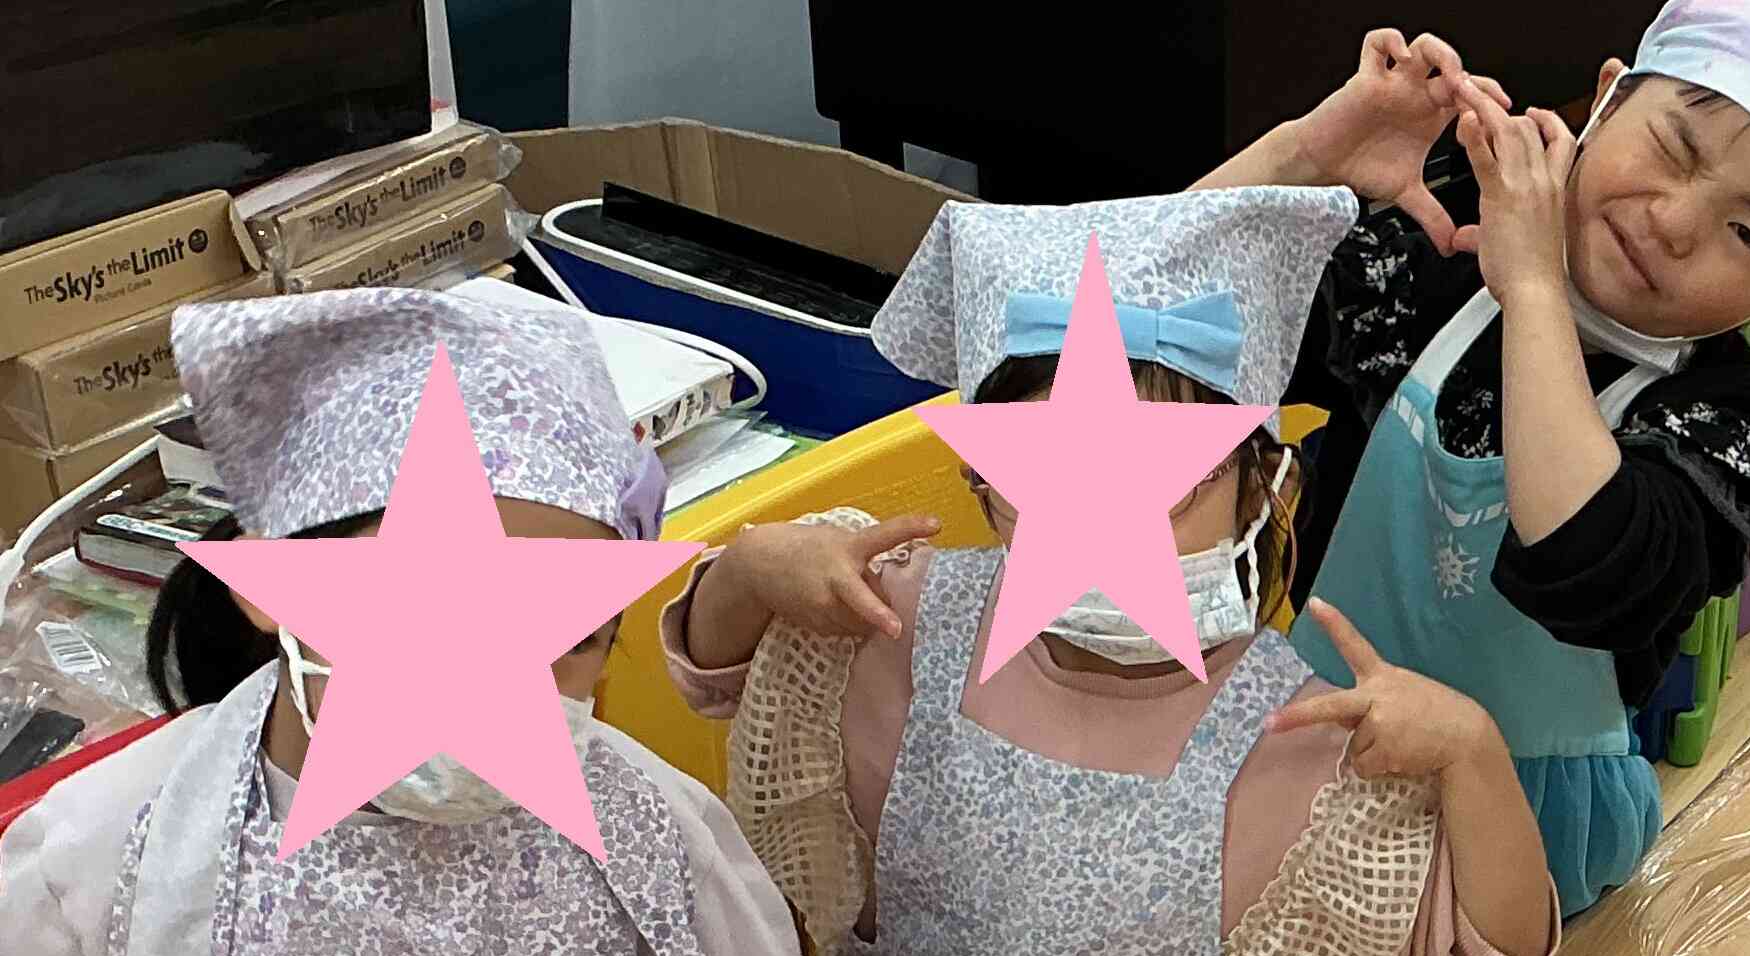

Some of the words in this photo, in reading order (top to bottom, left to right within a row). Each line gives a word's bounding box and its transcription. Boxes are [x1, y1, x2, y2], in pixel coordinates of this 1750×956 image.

[309, 214, 336, 233] The
[334, 194, 379, 230] Sky's
[379, 186, 400, 202] the
[399, 166, 447, 203] Limit
[23, 284, 54, 304] The
[52, 264, 105, 303] Sky's
[106, 258, 131, 276] the
[130, 237, 185, 275] Limit
[73, 375, 103, 395] The
[102, 353, 152, 392] Sky's
